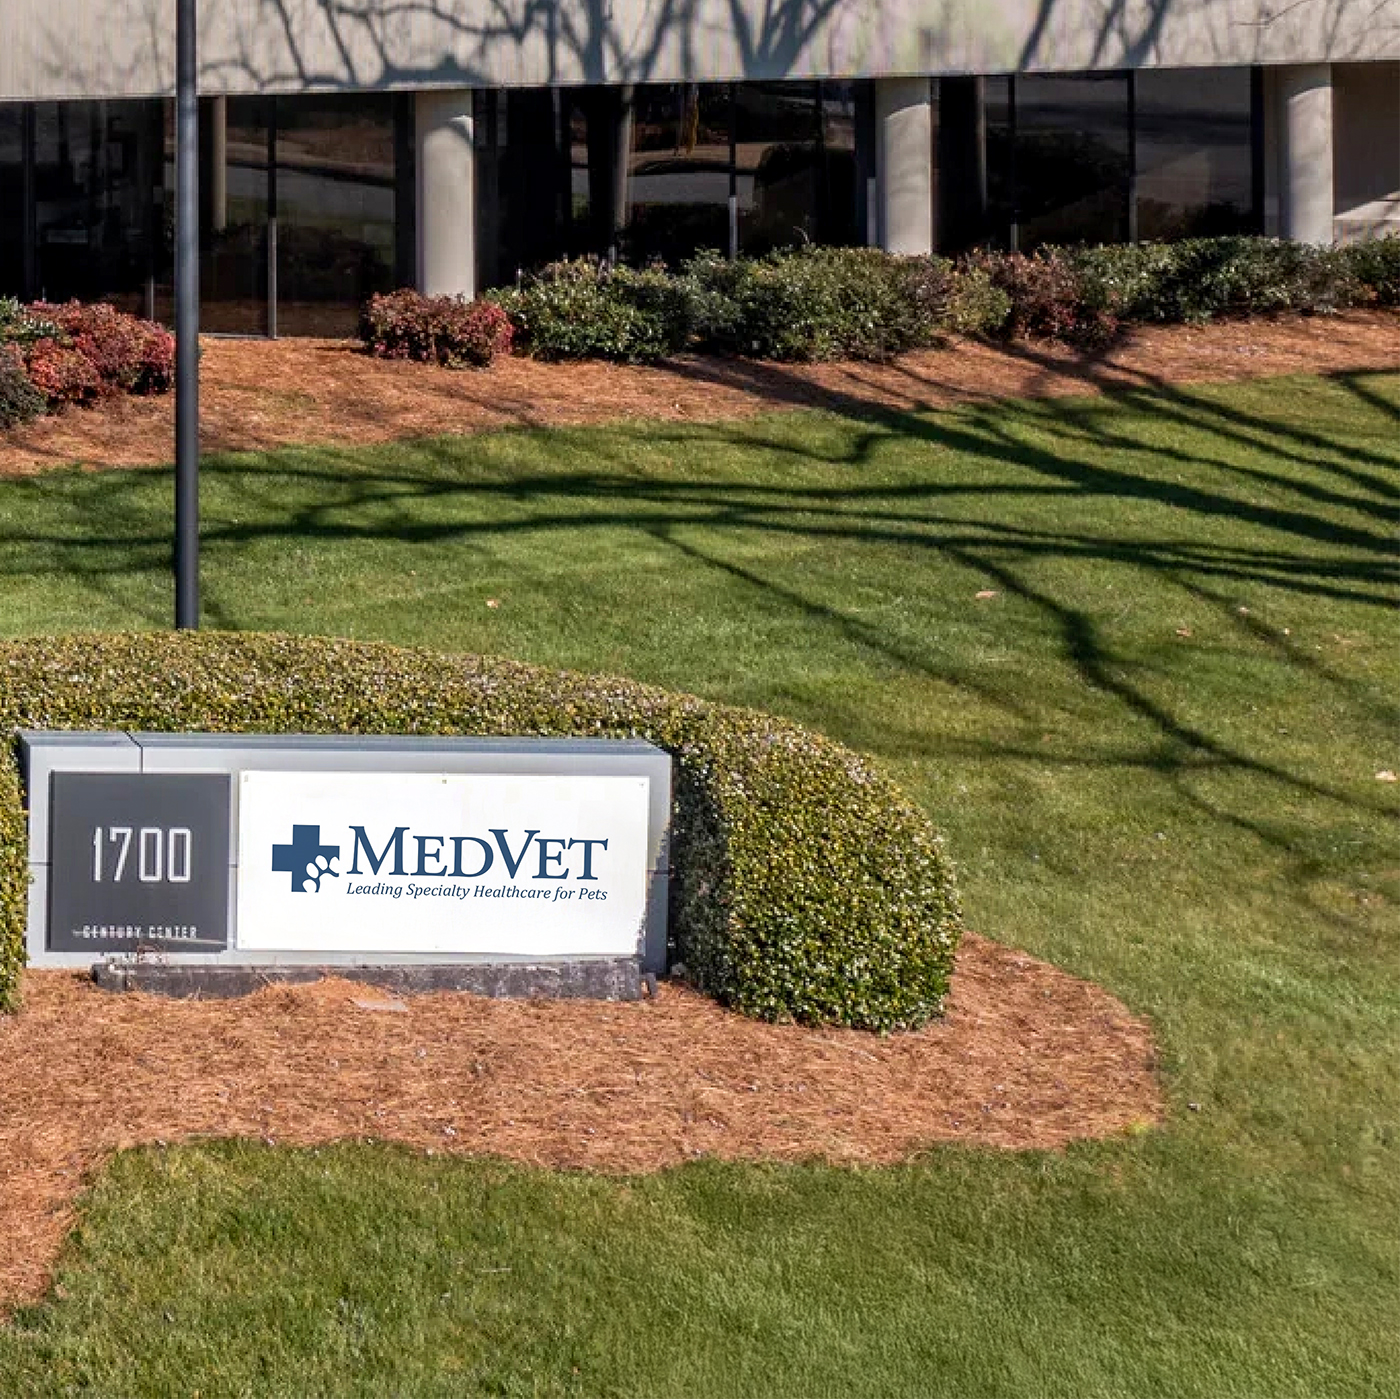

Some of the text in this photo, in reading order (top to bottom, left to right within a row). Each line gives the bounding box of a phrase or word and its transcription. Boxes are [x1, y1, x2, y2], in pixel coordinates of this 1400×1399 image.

[93, 826, 192, 882] 1700
[346, 825, 609, 881] MEDVET
[346, 882, 608, 902] Leading Specialty Healthcare for Pets
[148, 925, 198, 940] CENTER
